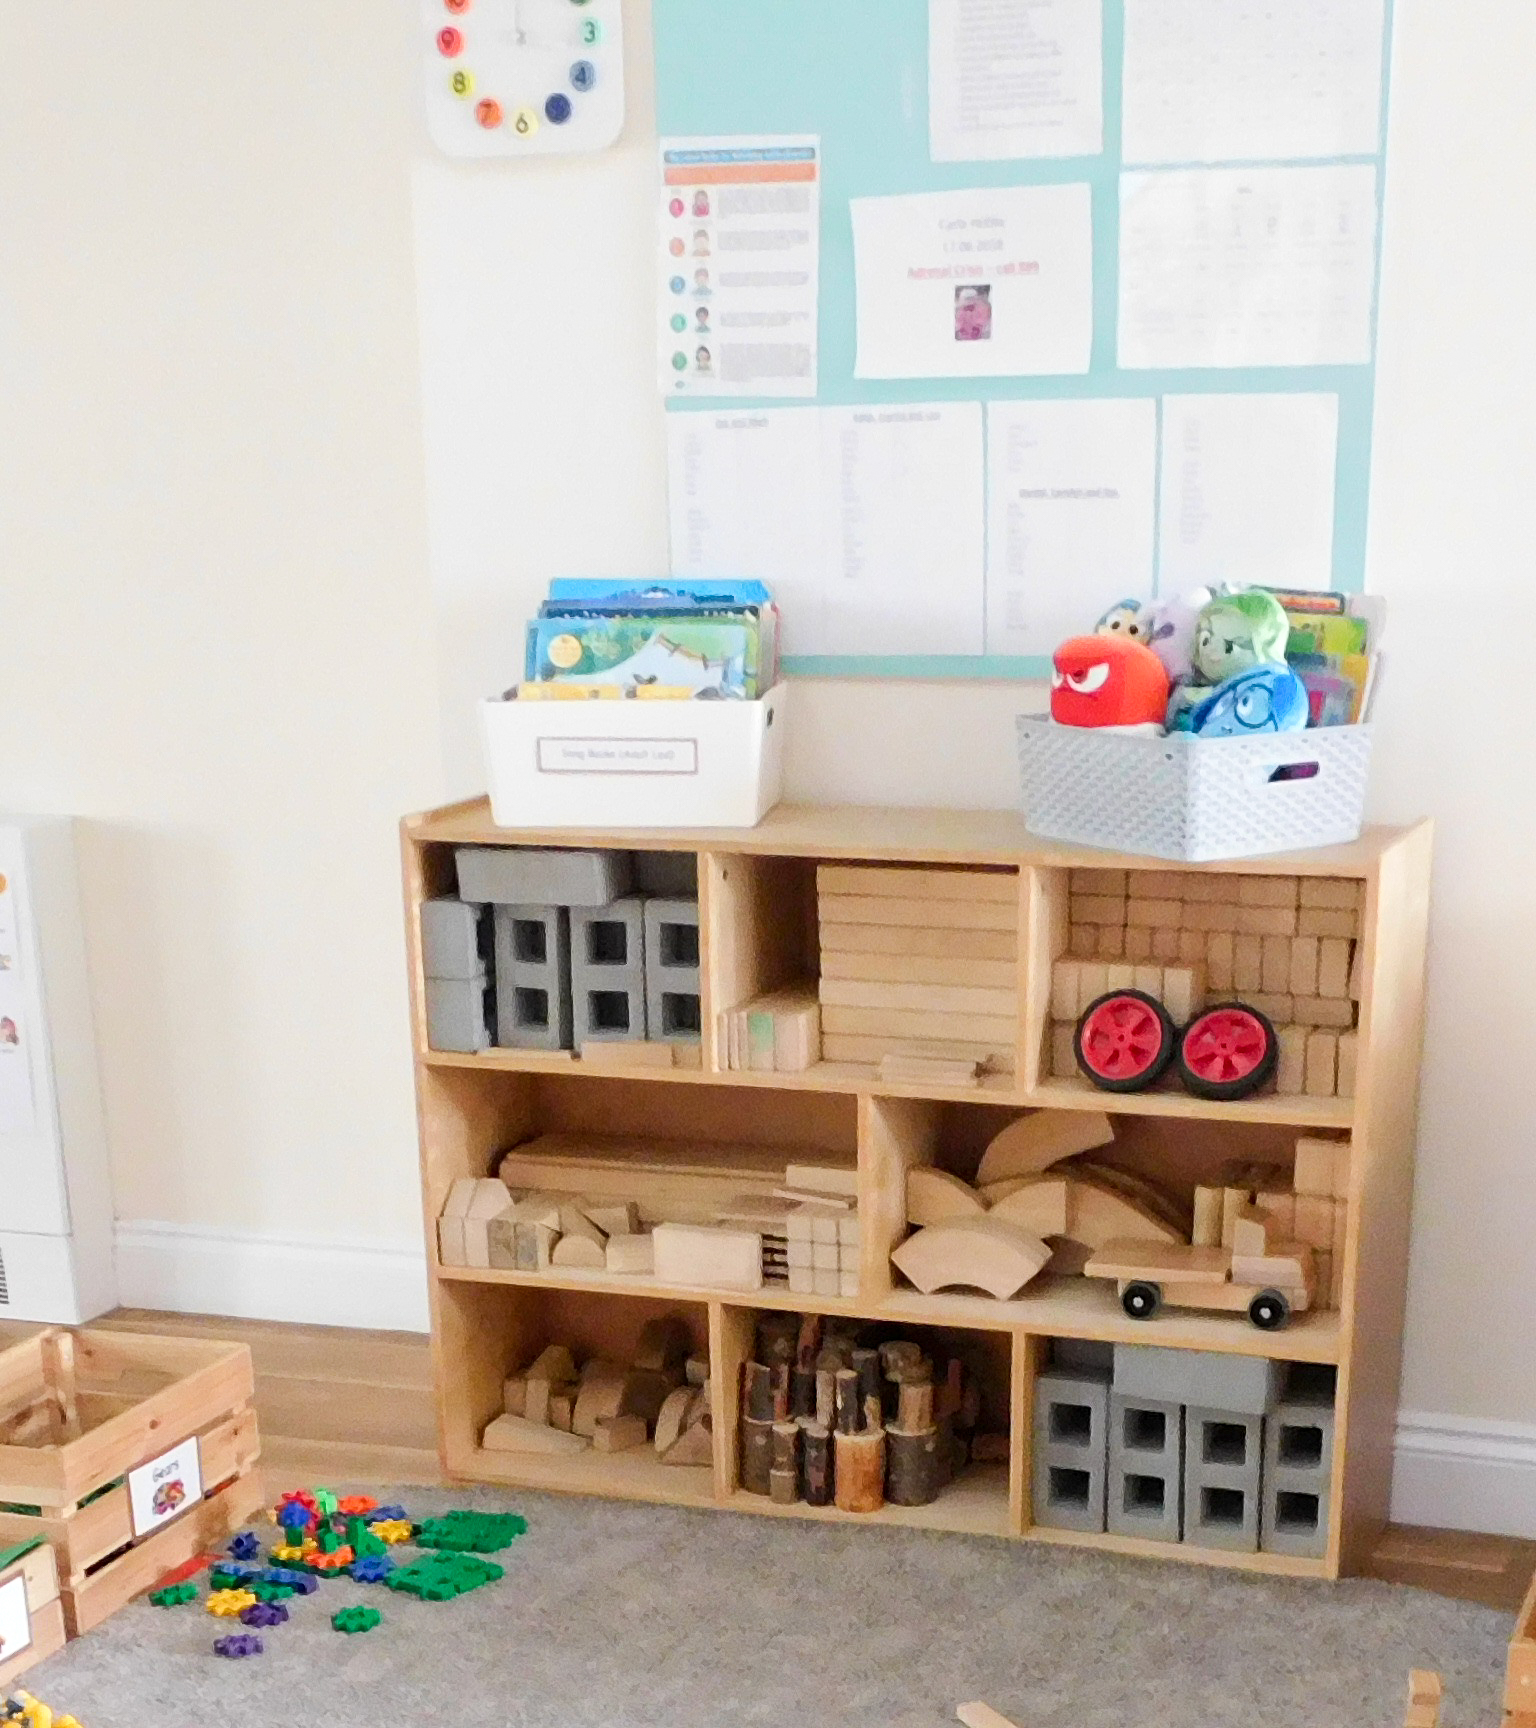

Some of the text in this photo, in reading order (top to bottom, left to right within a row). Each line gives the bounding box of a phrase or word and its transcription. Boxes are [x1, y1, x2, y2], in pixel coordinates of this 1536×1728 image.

[441, 30, 454, 49] 9
[585, 21, 595, 42] 3
[453, 71, 465, 93] 8
[576, 67, 586, 84] 4
[516, 114, 528, 133] 6
